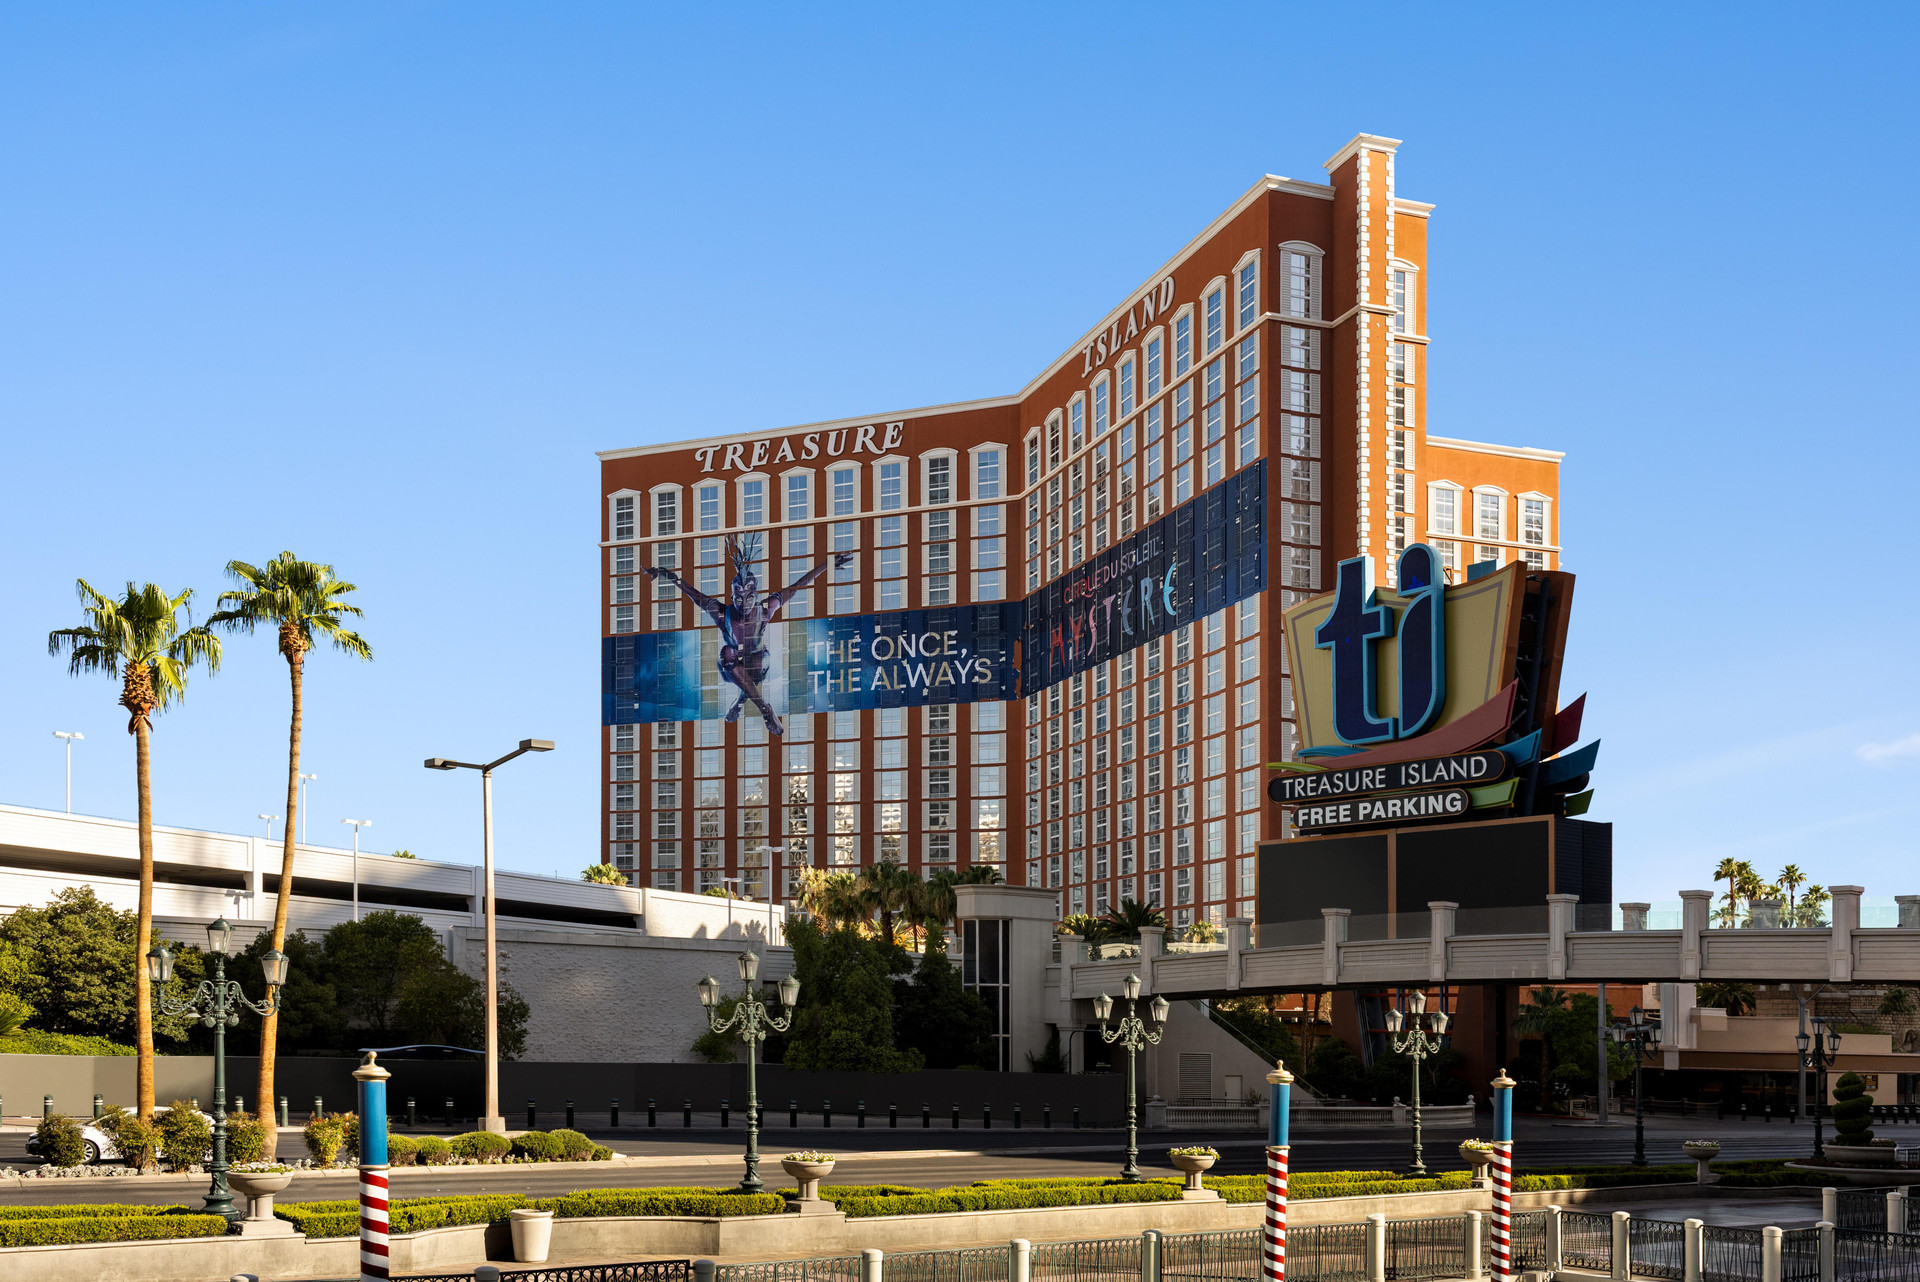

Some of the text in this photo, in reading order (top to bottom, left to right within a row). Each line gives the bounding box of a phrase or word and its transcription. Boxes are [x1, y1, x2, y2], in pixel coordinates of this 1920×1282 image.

[1081, 275, 1176, 378] ISLAND
[694, 421, 905, 474] TREASURE
[1063, 537, 1159, 605] CIRQUE DU SOLEIL
[808, 630, 968, 666] THE ONCE,
[808, 657, 992, 695] THE ALWAYS
[1281, 755, 1488, 799] TREASURE ISLAND
[1298, 792, 1463, 828] FREE PARKING
